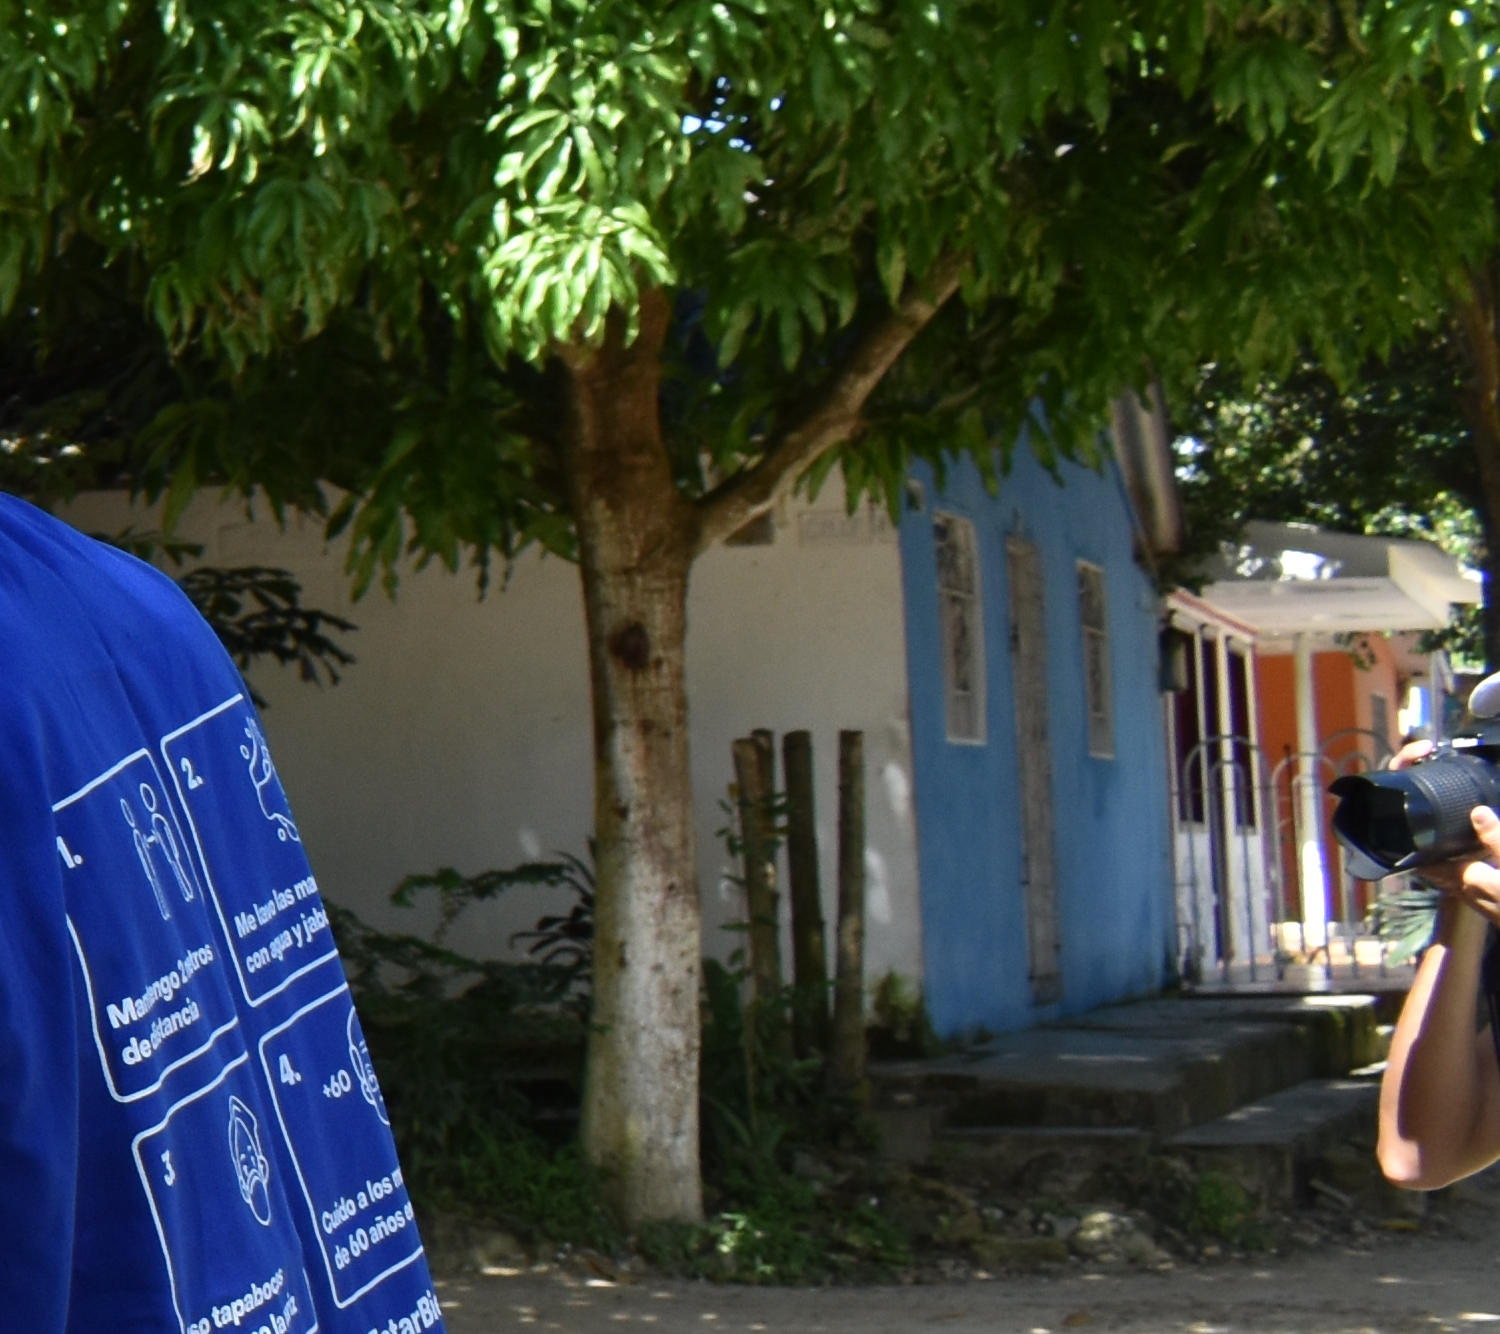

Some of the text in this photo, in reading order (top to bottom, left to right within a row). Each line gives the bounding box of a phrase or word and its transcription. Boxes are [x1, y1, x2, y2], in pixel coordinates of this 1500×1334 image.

[180, 757, 204, 790] 2.
[56, 836, 84, 869] 1.
[234, 911, 258, 938] Me
[272, 888, 295, 911] las
[246, 947, 271, 973] con
[291, 923, 303, 948] y
[278, 1053, 302, 1086] 4.
[322, 1069, 352, 1099] +60
[356, 1191, 369, 1209] a
[366, 1177, 394, 1202] los
[334, 1244, 350, 1271] de
[348, 1227, 370, 1257] 60
[368, 1210, 406, 1244] años
